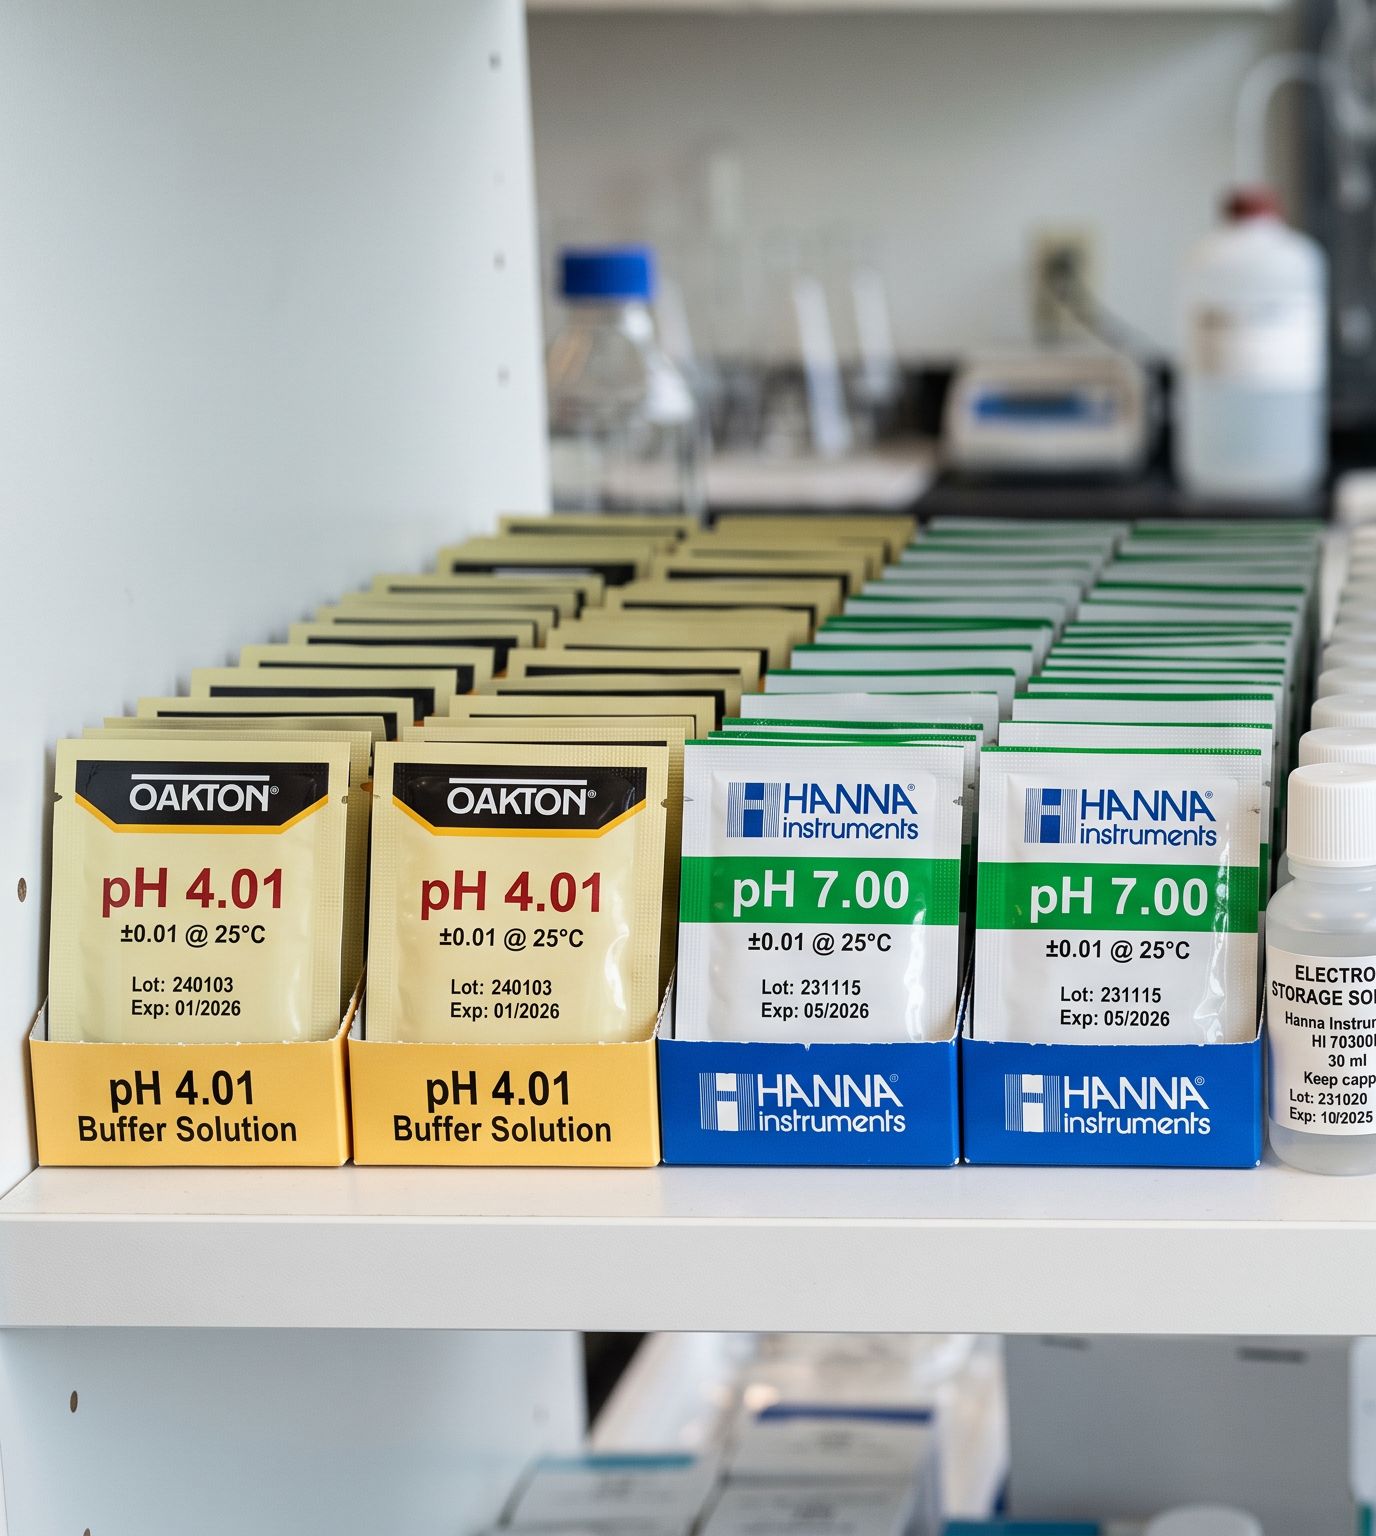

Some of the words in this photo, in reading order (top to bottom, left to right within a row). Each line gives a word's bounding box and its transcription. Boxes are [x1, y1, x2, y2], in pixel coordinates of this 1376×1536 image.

[783, 817, 918, 839] instruments
[1081, 823, 1216, 846] instruments
[103, 867, 167, 918] pH
[186, 868, 281, 909] 4.01
[421, 870, 486, 920] pH
[505, 872, 600, 912] 4.01
[734, 870, 794, 917] pH
[814, 871, 909, 908] 7.00
[1031, 877, 1092, 924] pH
[1112, 878, 1207, 916] 7.00
[121, 924, 175, 942] ±0.01
[215, 925, 265, 943] 25°C
[440, 928, 494, 946] ±0.01
[533, 929, 583, 947] 25°C
[748, 933, 802, 950] ±0.01
[842, 933, 891, 951] 25°C
[1046, 940, 1100, 957] ±0.01
[1140, 941, 1189, 959] 25°C
[133, 977, 164, 992] Lot:
[173, 977, 233, 992] 240103
[452, 979, 483, 994] Lot:
[492, 980, 551, 995] 240103
[762, 979, 793, 994] Lot:
[801, 980, 860, 995] 231115
[1272, 981, 1342, 1005] STORAGE
[1061, 987, 1093, 1002] Lot:
[1101, 987, 1161, 1003] 231115
[132, 1000, 169, 1019] Exp:
[176, 1000, 240, 1016] 01/2026
[451, 1002, 487, 1022] Exp:
[494, 1003, 559, 1019] 01/2026
[762, 1002, 798, 1021] Exp:
[805, 1003, 868, 1018] 05/2026
[1061, 1010, 1097, 1029] Exp:
[1105, 1010, 1169, 1026] 05/2026
[1286, 1011, 1324, 1029] Hanna
[1313, 1035, 1325, 1048] HI
[1329, 1055, 1344, 1067] 30
[1350, 1054, 1366, 1066] ml
[1305, 1071, 1337, 1088] Keep
[110, 1071, 161, 1113] pH
[176, 1070, 252, 1105] 4.01
[427, 1071, 477, 1113] pH
[492, 1071, 568, 1105] 4.01
[1318, 1093, 1367, 1105] 231020
[759, 1109, 905, 1132] instruments
[1064, 1112, 1210, 1134] instruments
[1321, 1111, 1373, 1124] 10/2025
[78, 1116, 166, 1142] Buffer
[177, 1116, 296, 1142] Solution
[394, 1115, 482, 1141] Buffer
[492, 1116, 611, 1142] Solution
